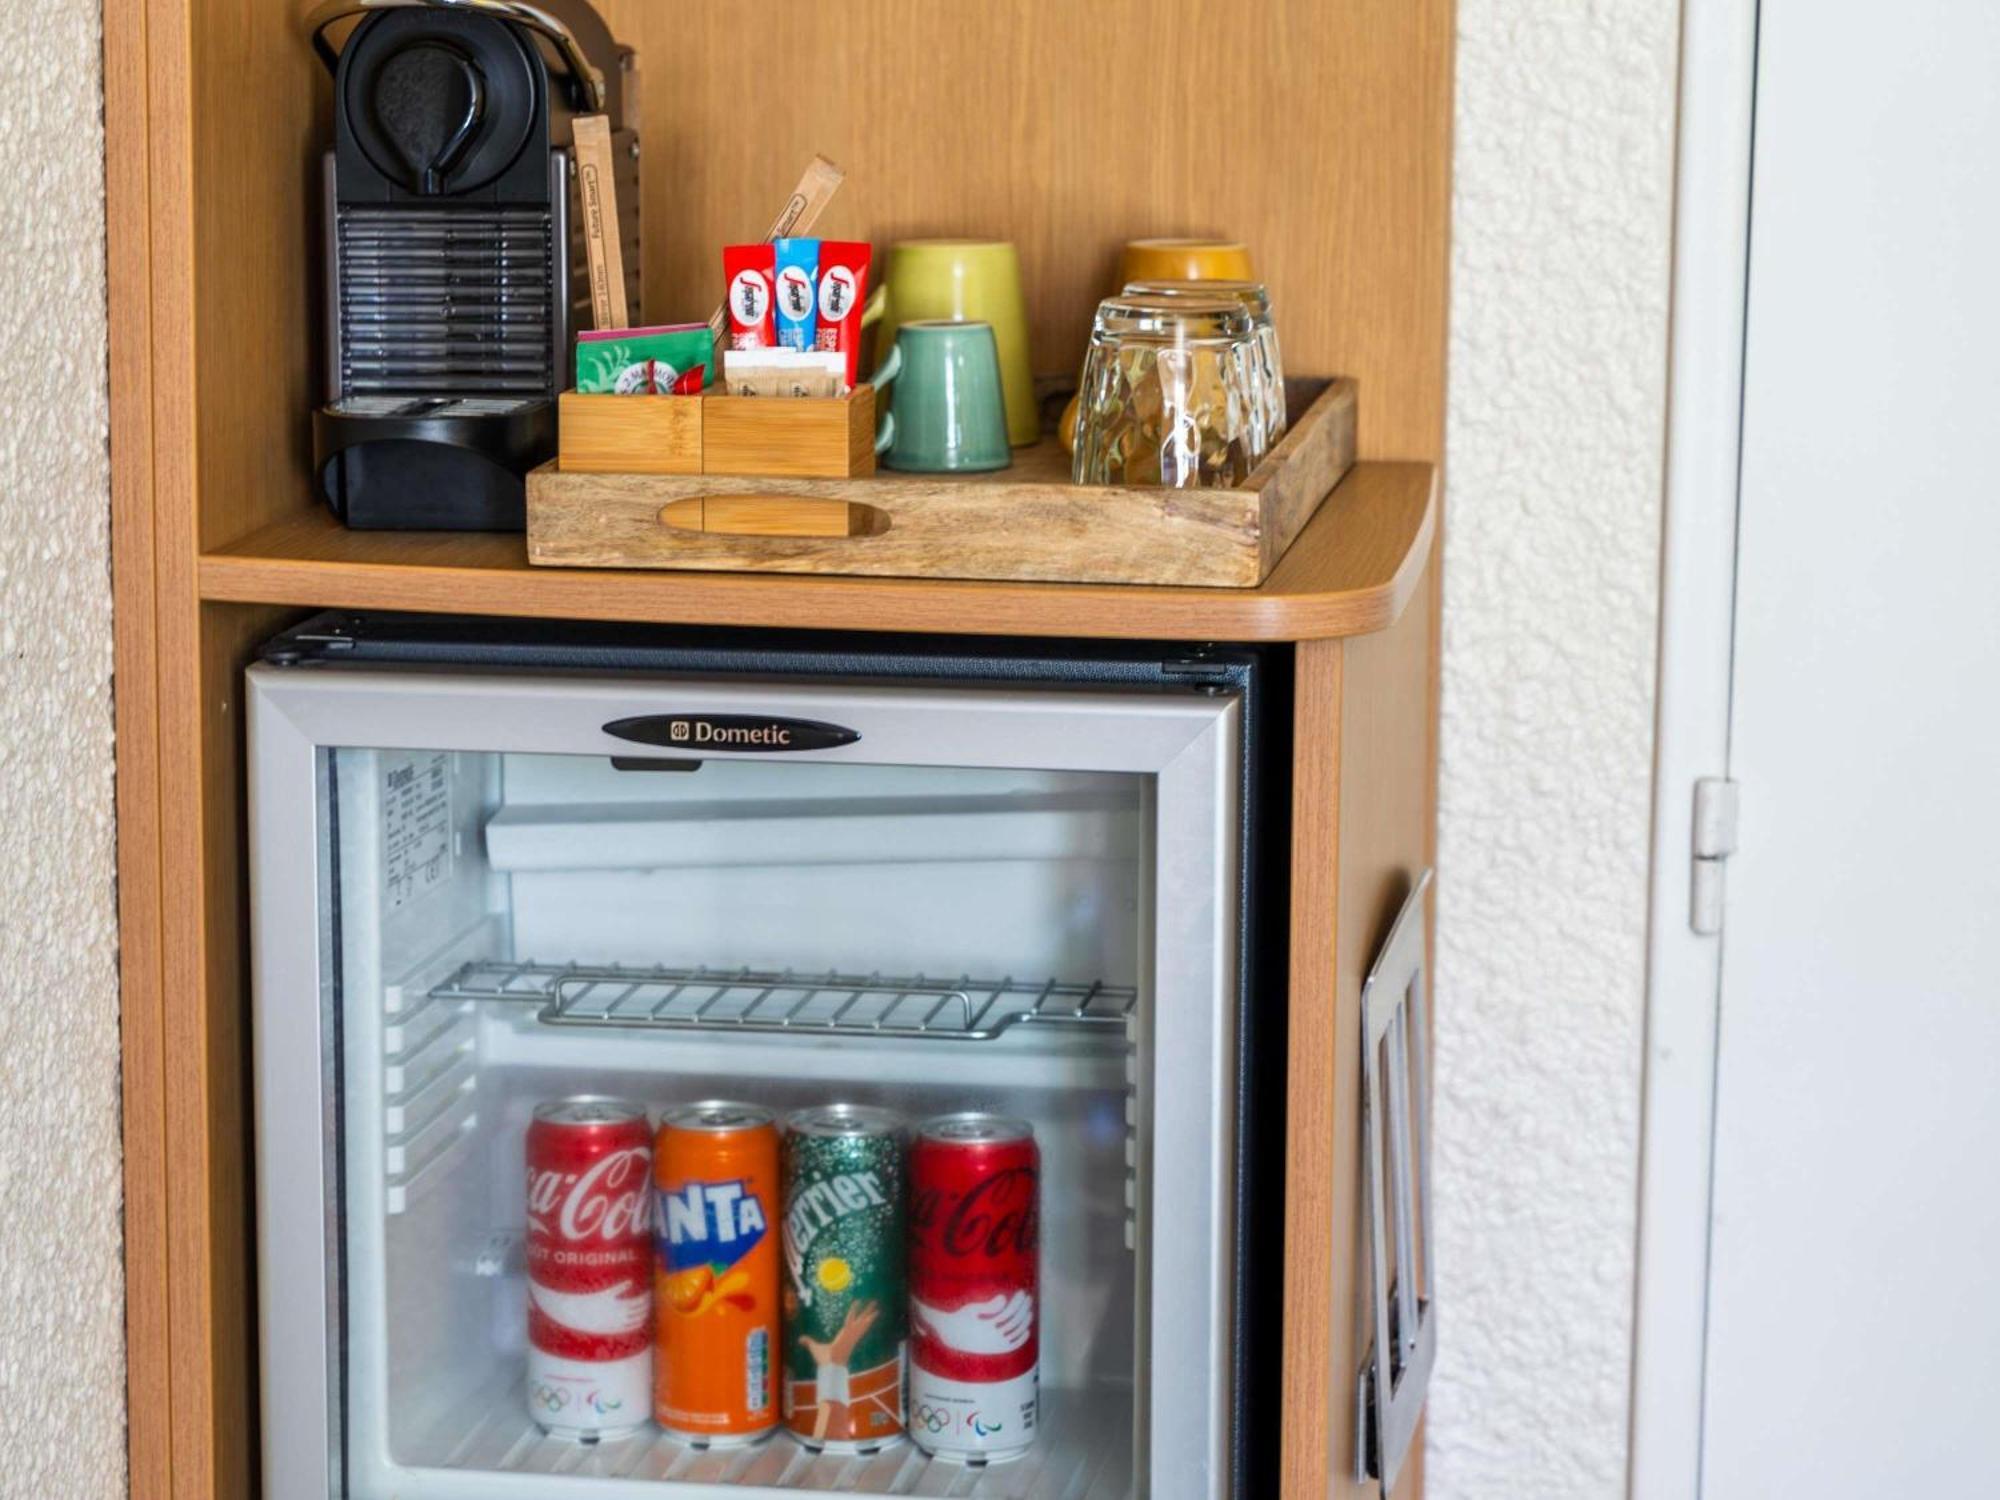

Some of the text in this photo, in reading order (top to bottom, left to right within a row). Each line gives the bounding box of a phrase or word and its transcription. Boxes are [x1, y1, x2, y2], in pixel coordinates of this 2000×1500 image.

[591, 209, 600, 239] Future
[695, 722, 791, 744] Dometic
[554, 1249, 637, 1266] ORIGINAL
